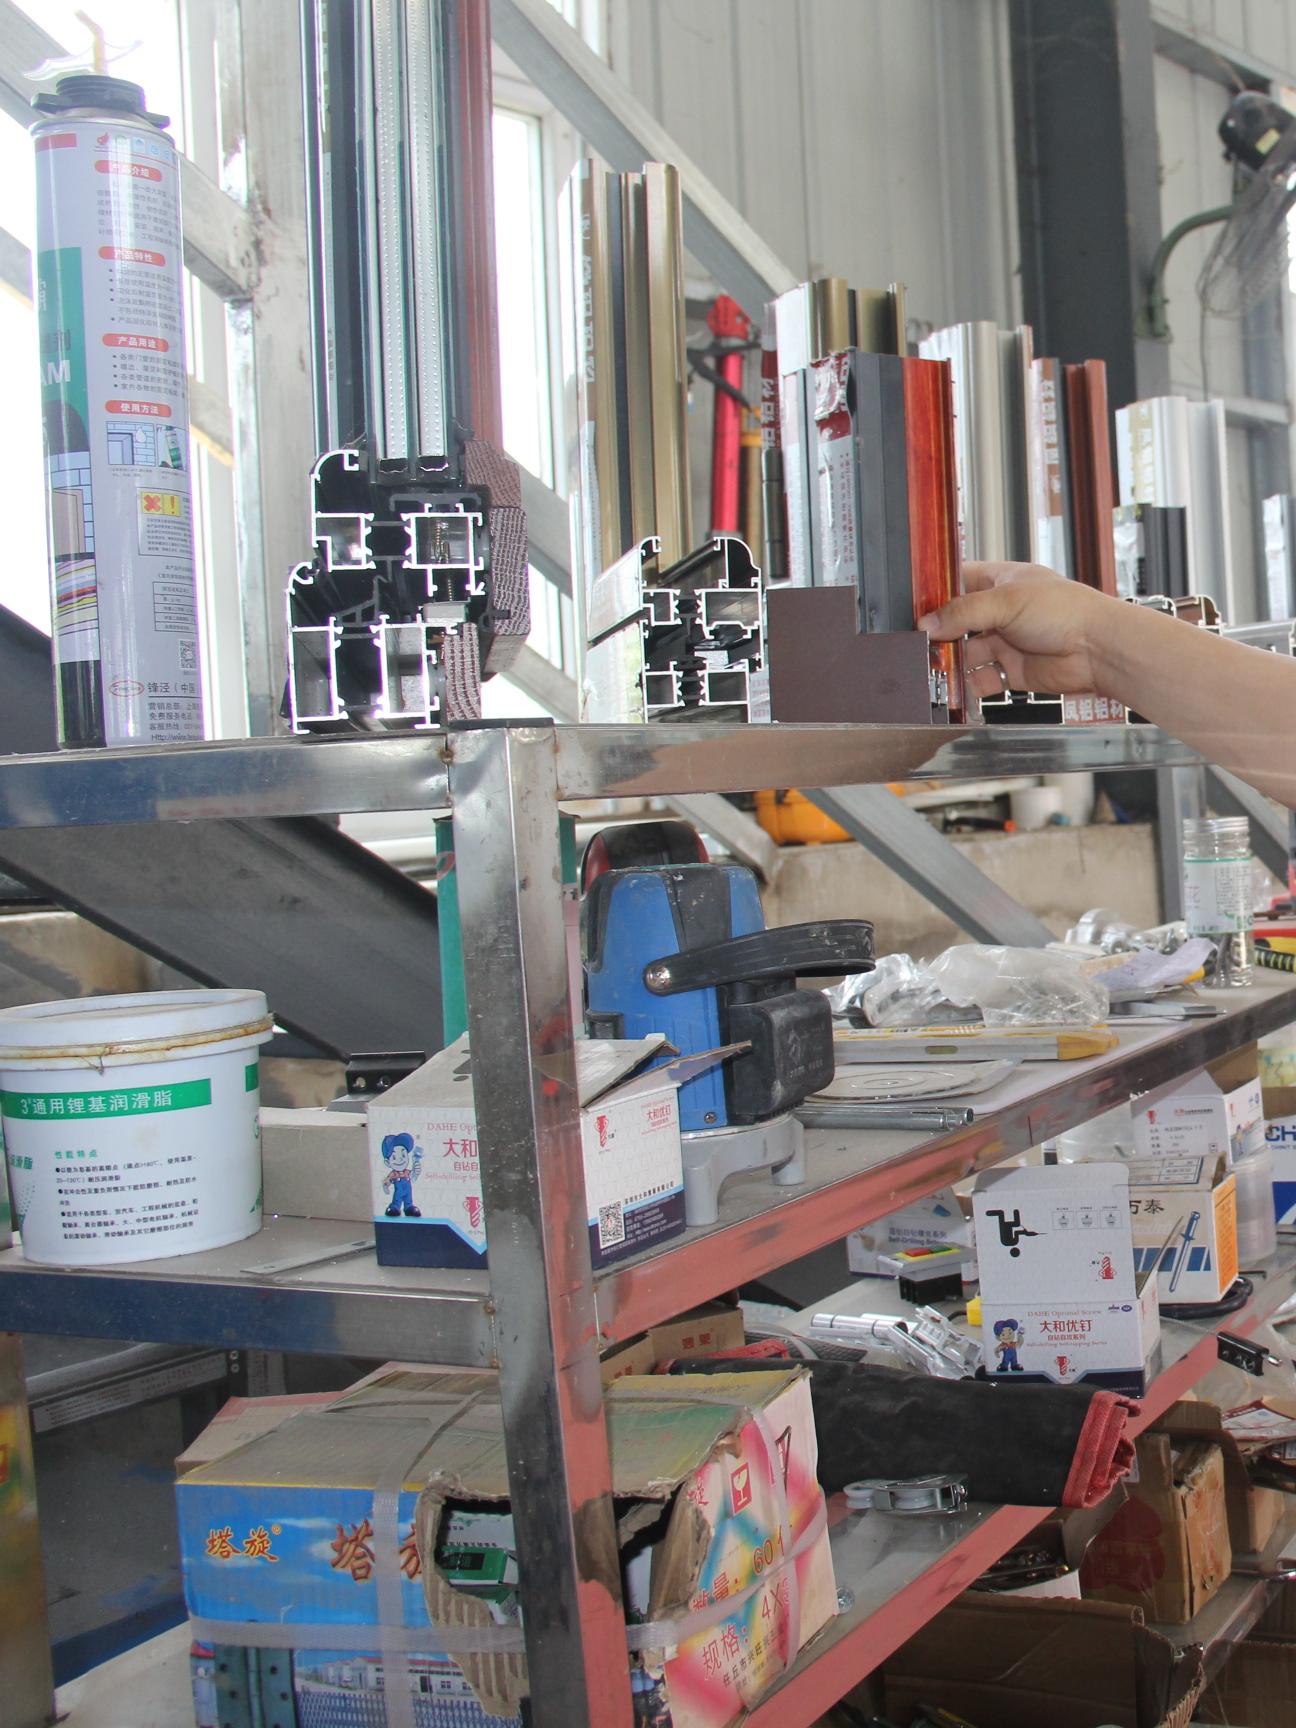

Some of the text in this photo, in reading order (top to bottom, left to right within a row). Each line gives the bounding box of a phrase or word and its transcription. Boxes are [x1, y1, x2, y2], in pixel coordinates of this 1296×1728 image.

[117, 336, 157, 349] 产品用途
[120, 402, 160, 415] 使用方法
[442, 1138, 478, 1158] 大和
[1040, 1319, 1093, 1333] 大和优钉
[206, 1525, 280, 1564] 塔旋
